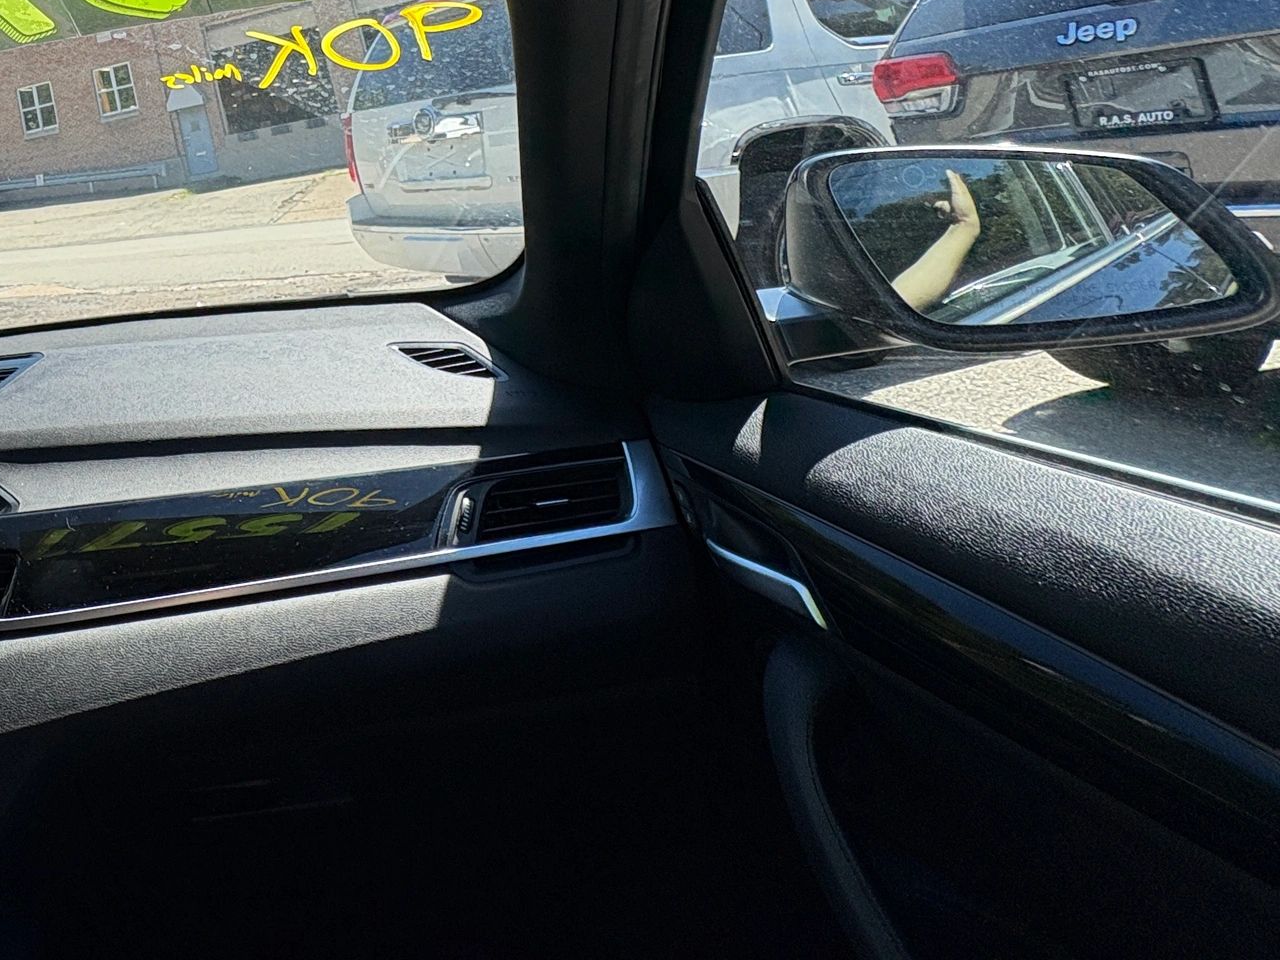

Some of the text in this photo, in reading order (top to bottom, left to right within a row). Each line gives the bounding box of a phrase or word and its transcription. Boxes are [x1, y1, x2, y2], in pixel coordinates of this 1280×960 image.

[1056, 18, 1137, 45] Jeep
[1099, 114, 1136, 127] R.A.S.
[1137, 110, 1174, 123] AUTO
